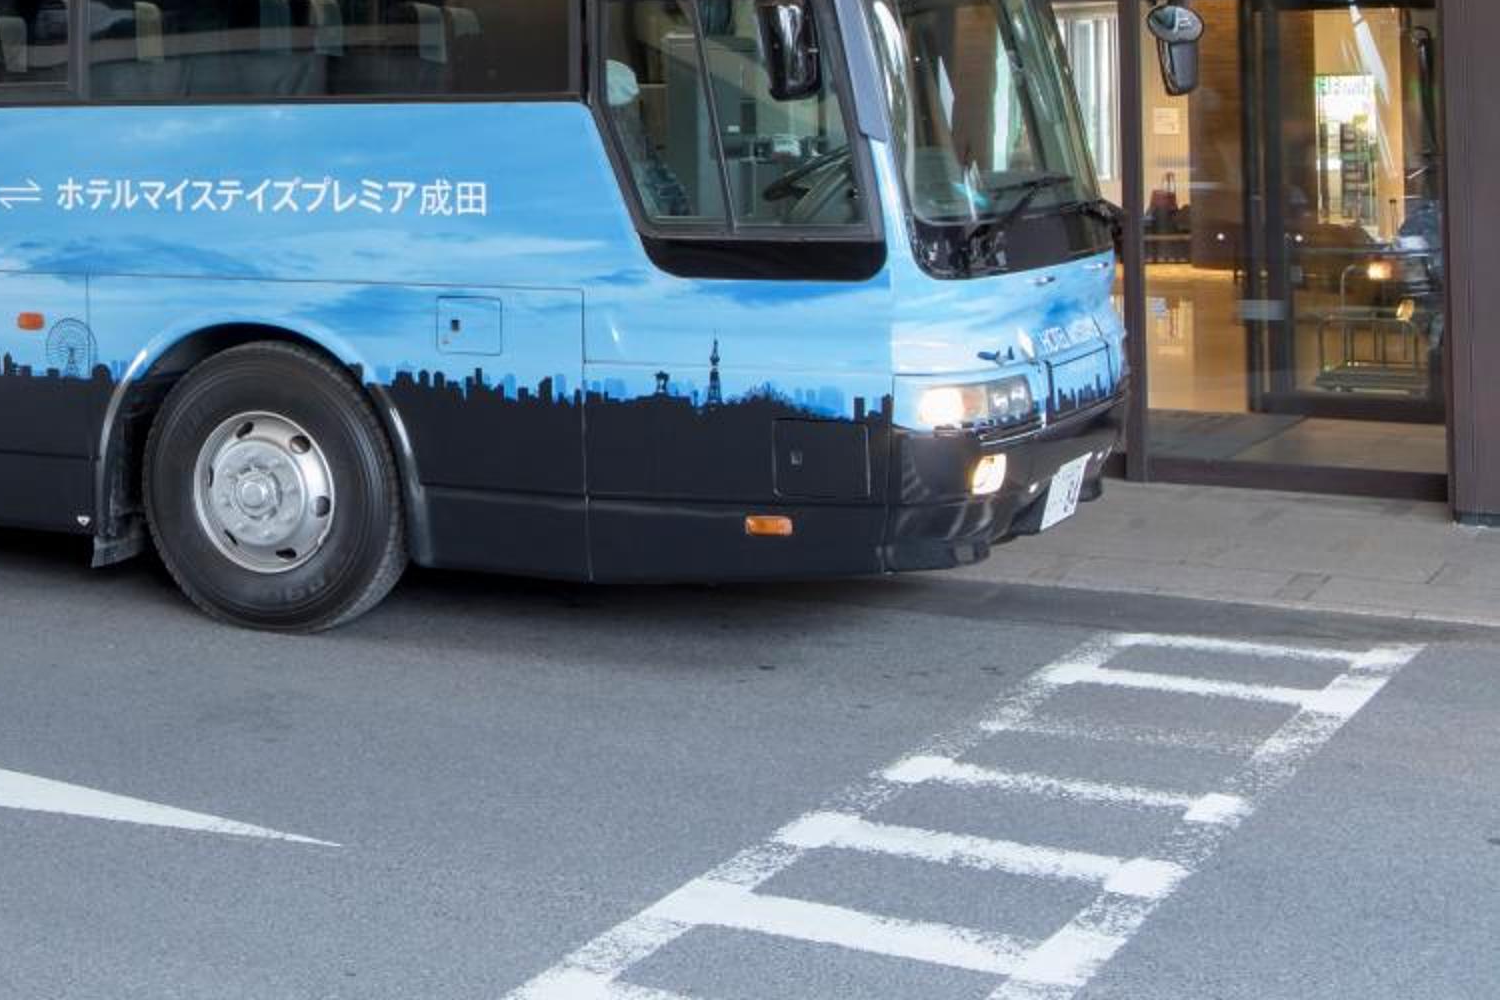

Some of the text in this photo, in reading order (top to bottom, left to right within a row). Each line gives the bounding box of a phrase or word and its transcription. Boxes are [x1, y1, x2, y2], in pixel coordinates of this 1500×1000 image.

[56, 175, 489, 217] ホテルマイステイズプレミア成田
